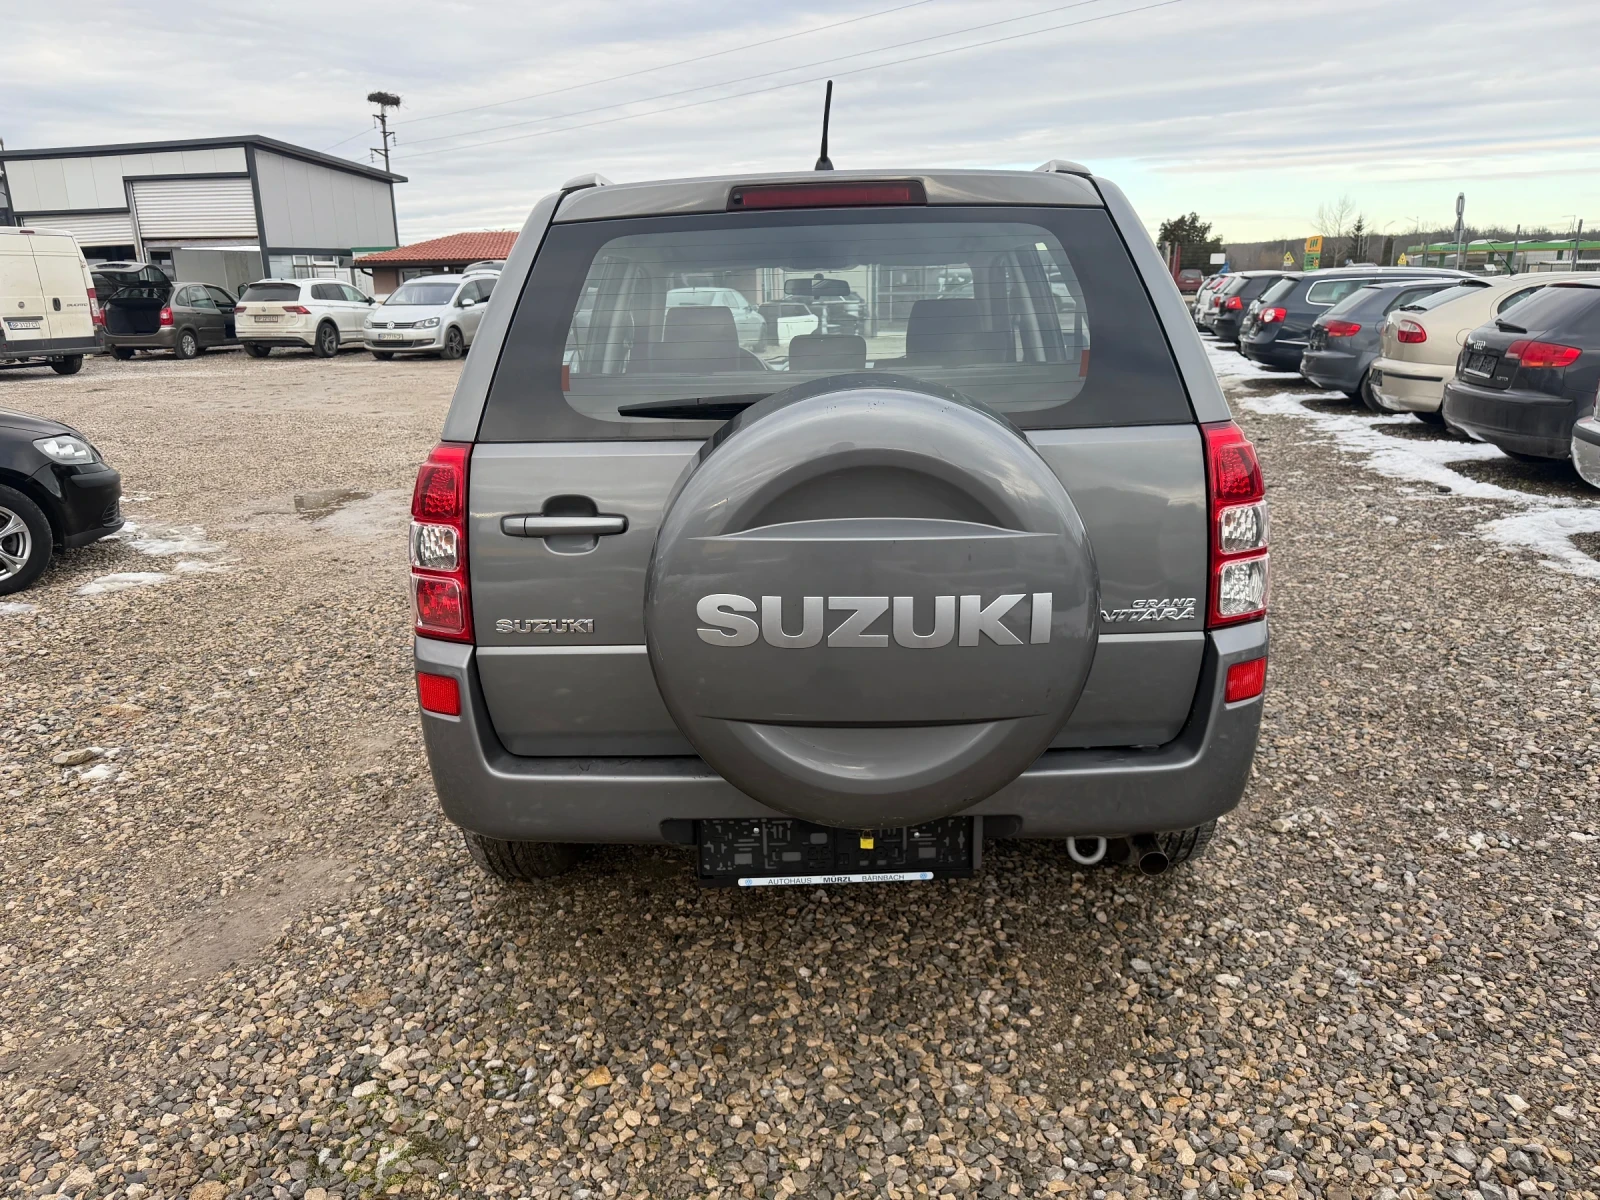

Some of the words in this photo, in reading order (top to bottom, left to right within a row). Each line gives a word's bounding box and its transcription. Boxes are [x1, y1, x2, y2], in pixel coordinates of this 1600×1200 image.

[1132, 597, 1197, 609] GRAND
[696, 592, 1053, 649] SUZUKI
[1101, 607, 1195, 622] VITARA
[495, 618, 595, 634] SUZUKI
[768, 877, 812, 885] AUTOHAUS
[823, 875, 852, 883] MÜRZL
